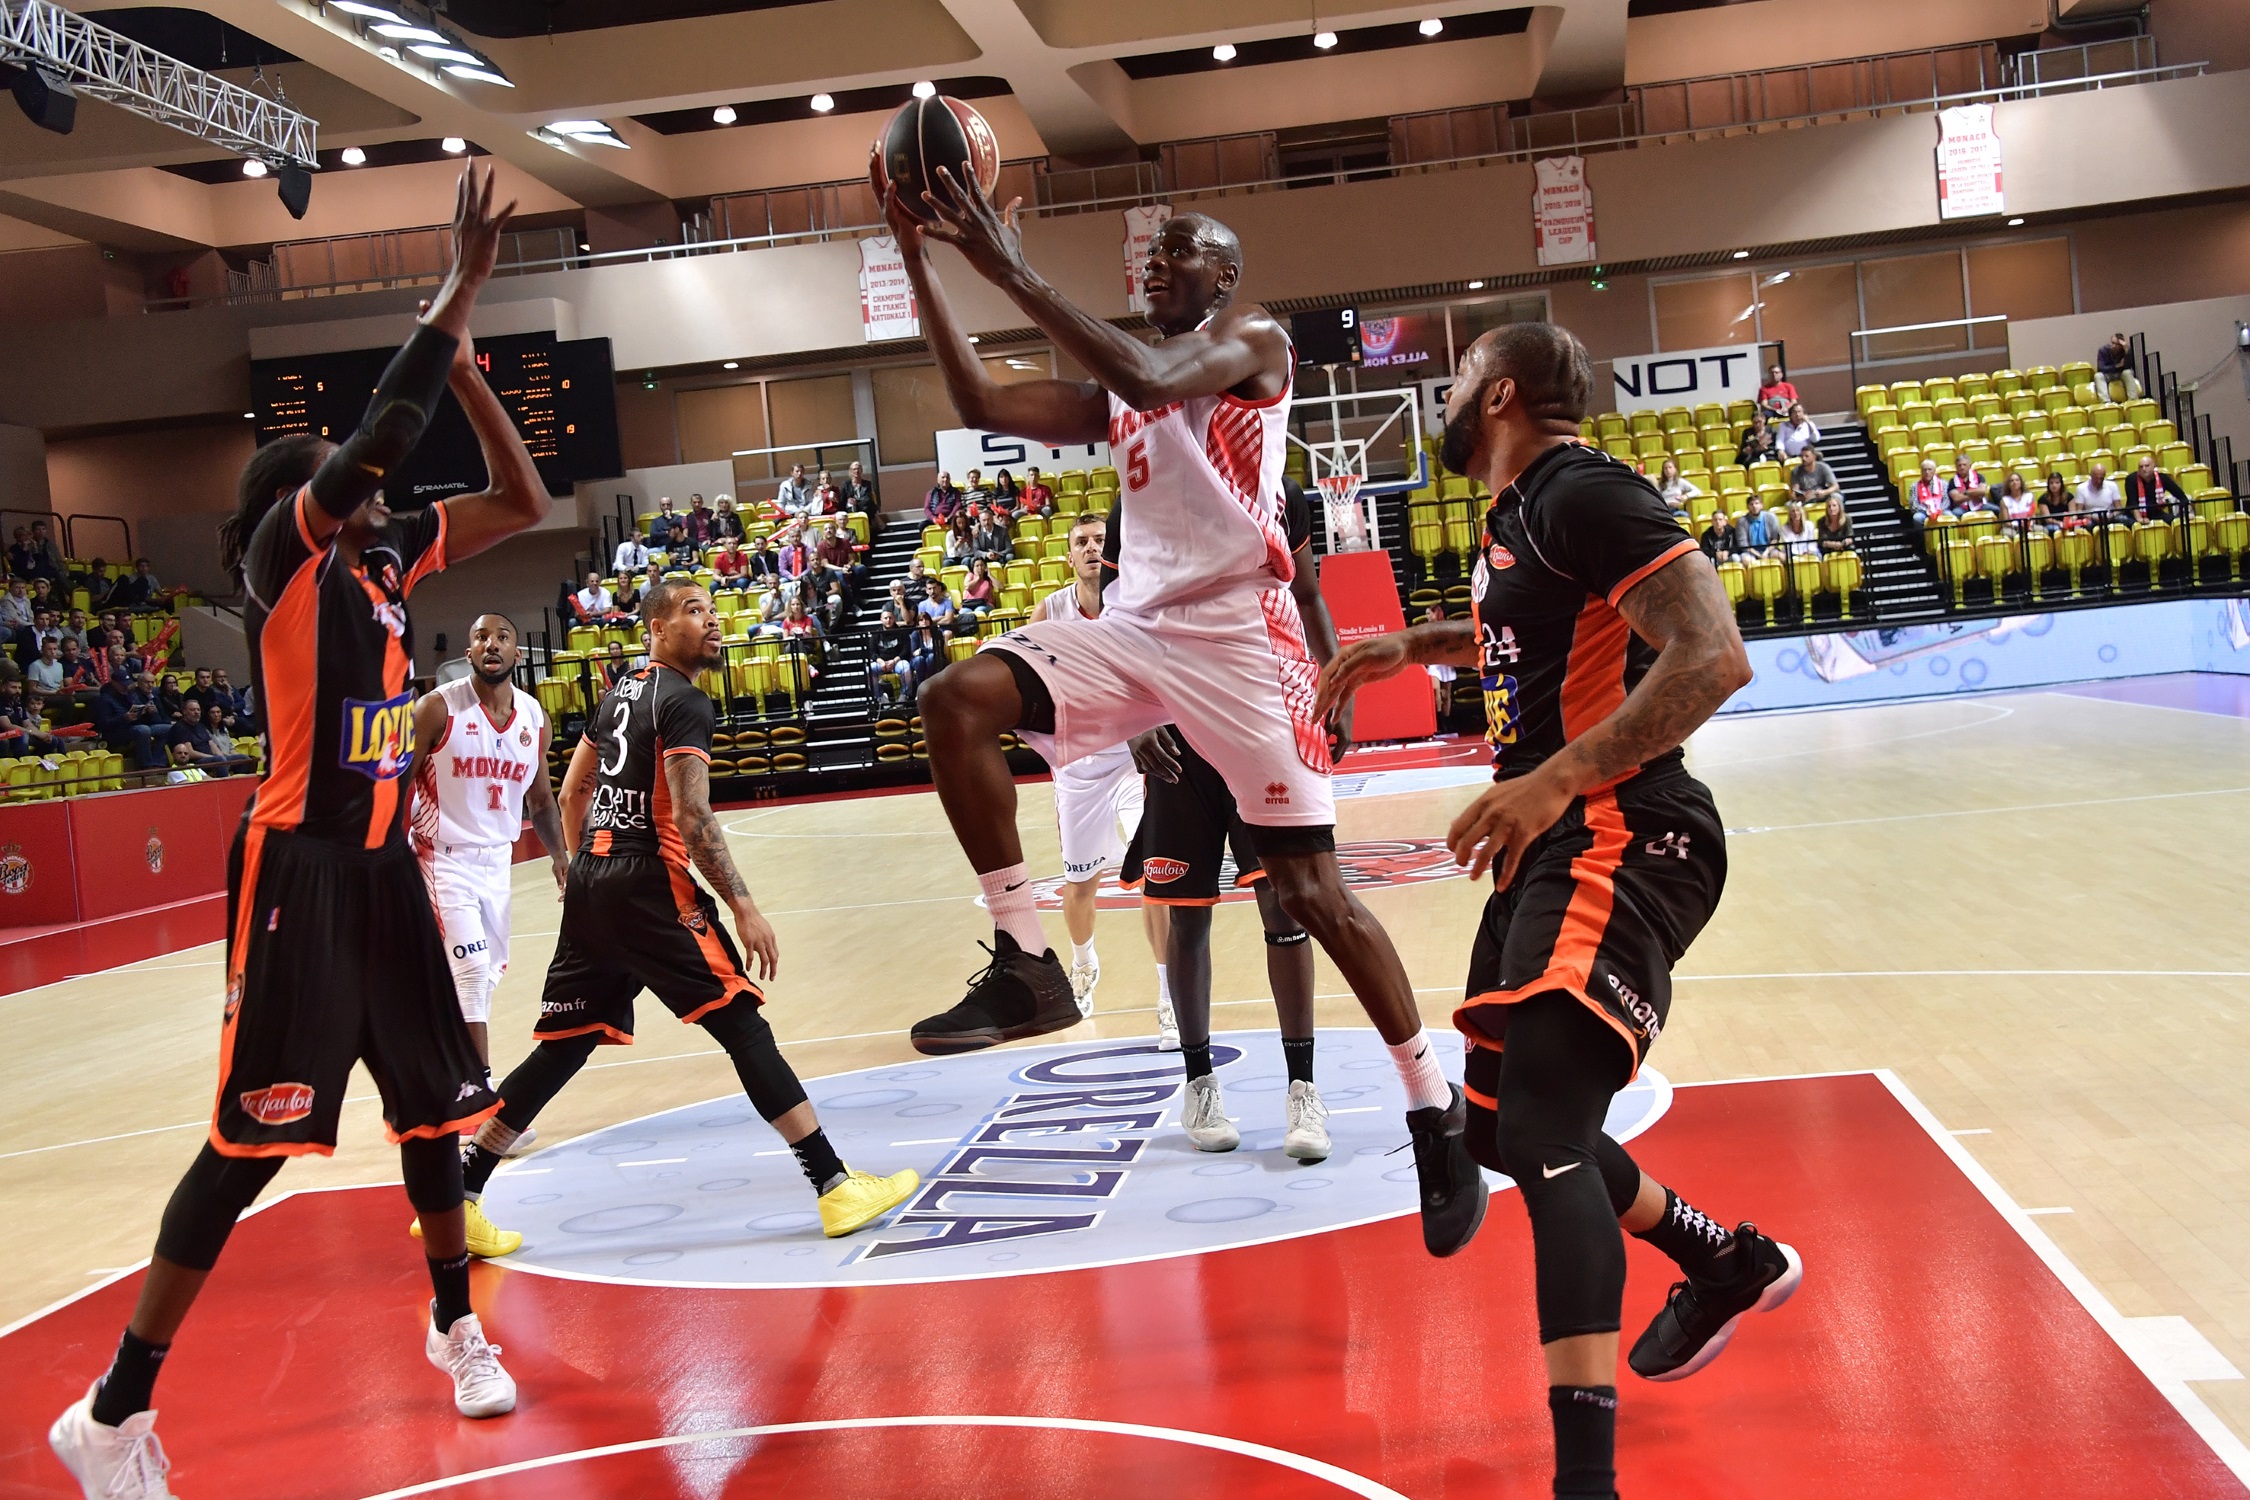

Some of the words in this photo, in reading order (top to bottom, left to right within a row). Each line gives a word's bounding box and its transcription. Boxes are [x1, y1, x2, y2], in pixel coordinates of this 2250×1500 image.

[1948, 133, 1987, 144] MONACO
[1543, 184, 1580, 196] MONACO
[1133, 234, 1152, 244] MON
[868, 262, 904, 273] MONACO
[870, 278, 905, 289] 2013/2014
[872, 294, 905, 303] CHAMPION
[873, 305, 882, 313] DE
[882, 303, 907, 312] FRANCE
[871, 312, 906, 322] NATIONALE
[1341, 309, 1354, 328] 9
[476, 352, 490, 372] 4
[317, 381, 324, 391] 5
[562, 379, 570, 389] 10
[1127, 439, 1150, 493] 5
[413, 482, 469, 494] STRAMATEL
[1339, 627, 1358, 635] Stade
[1358, 625, 1377, 634] Louis
[600, 701, 630, 776] 3
[452, 756, 530, 784] MONAC
[1064, 856, 1106, 873] OREZZA
